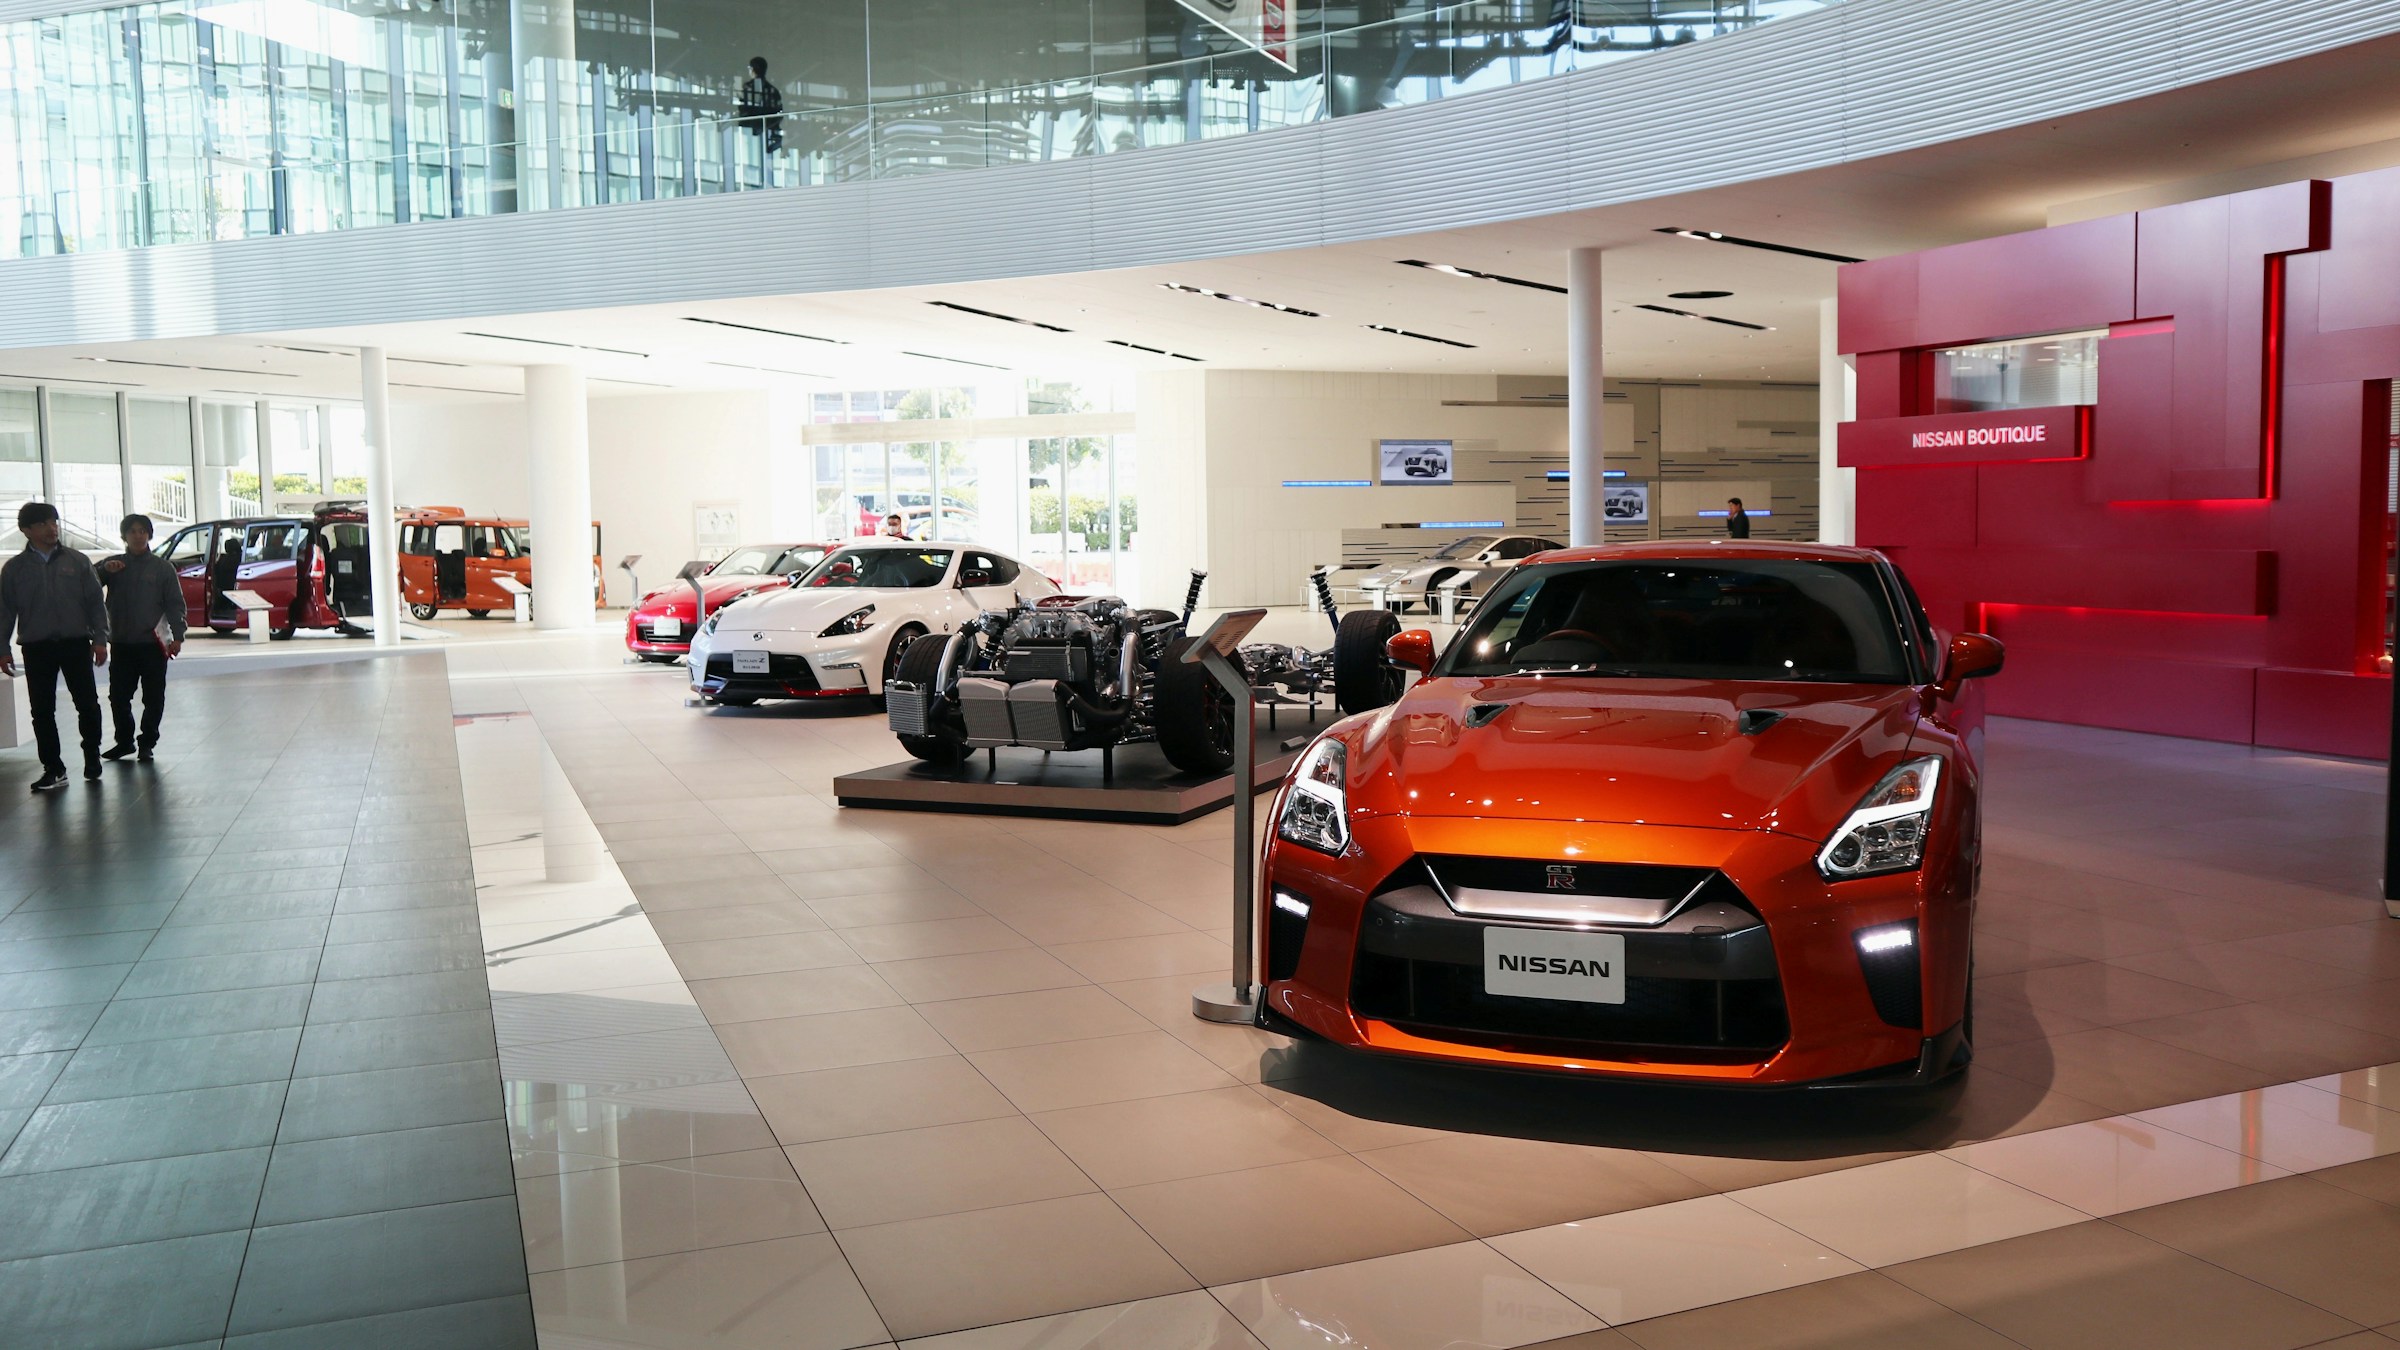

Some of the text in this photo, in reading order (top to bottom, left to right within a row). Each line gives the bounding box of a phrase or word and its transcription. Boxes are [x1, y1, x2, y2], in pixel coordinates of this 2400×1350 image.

[1912, 425, 2045, 448] NISSAN BOUTIQUE
[1545, 865, 1577, 873] GT
[1546, 873, 1576, 889] R
[1499, 954, 1609, 978] NISSAN
